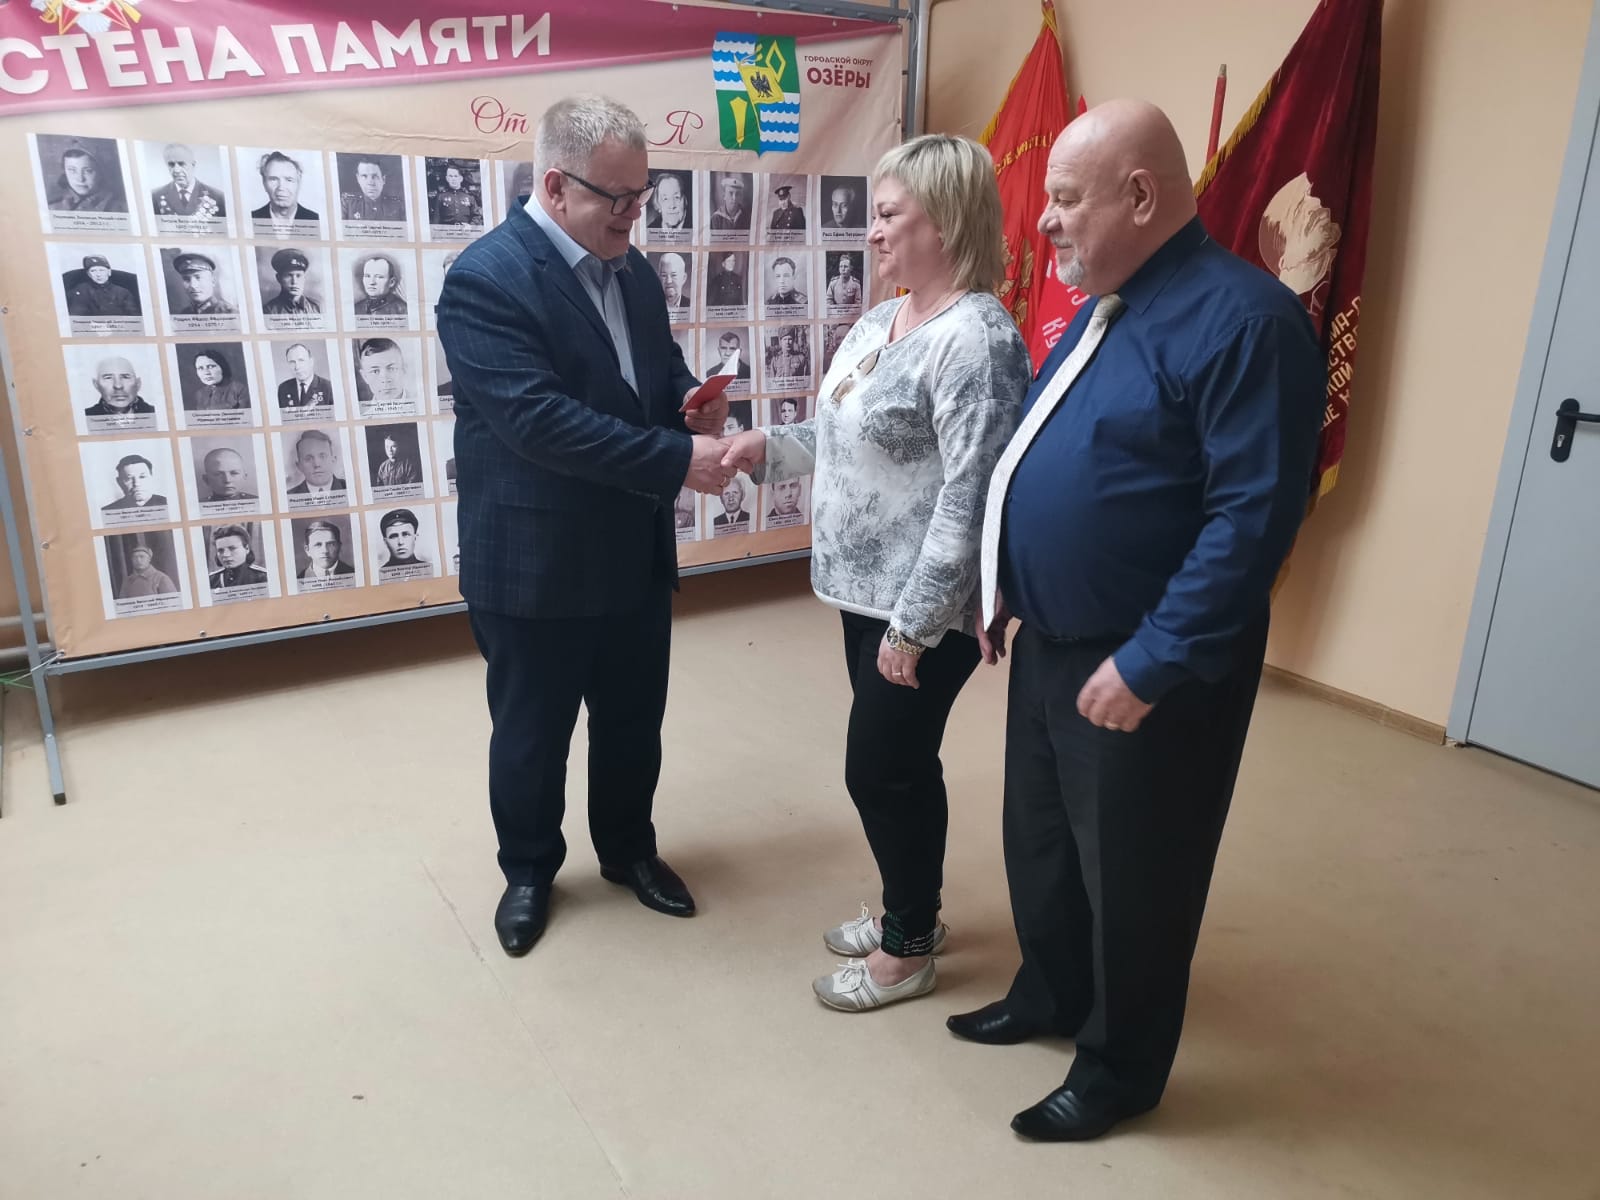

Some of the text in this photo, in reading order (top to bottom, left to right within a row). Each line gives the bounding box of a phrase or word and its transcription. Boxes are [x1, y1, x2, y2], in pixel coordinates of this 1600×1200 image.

[0, 12, 550, 94] СТЕНА ПАМЯТИ
[804, 55, 873, 67] ГОРОДСКОЙ ОКРУГ
[807, 64, 871, 88] ОЗЁРЫ
